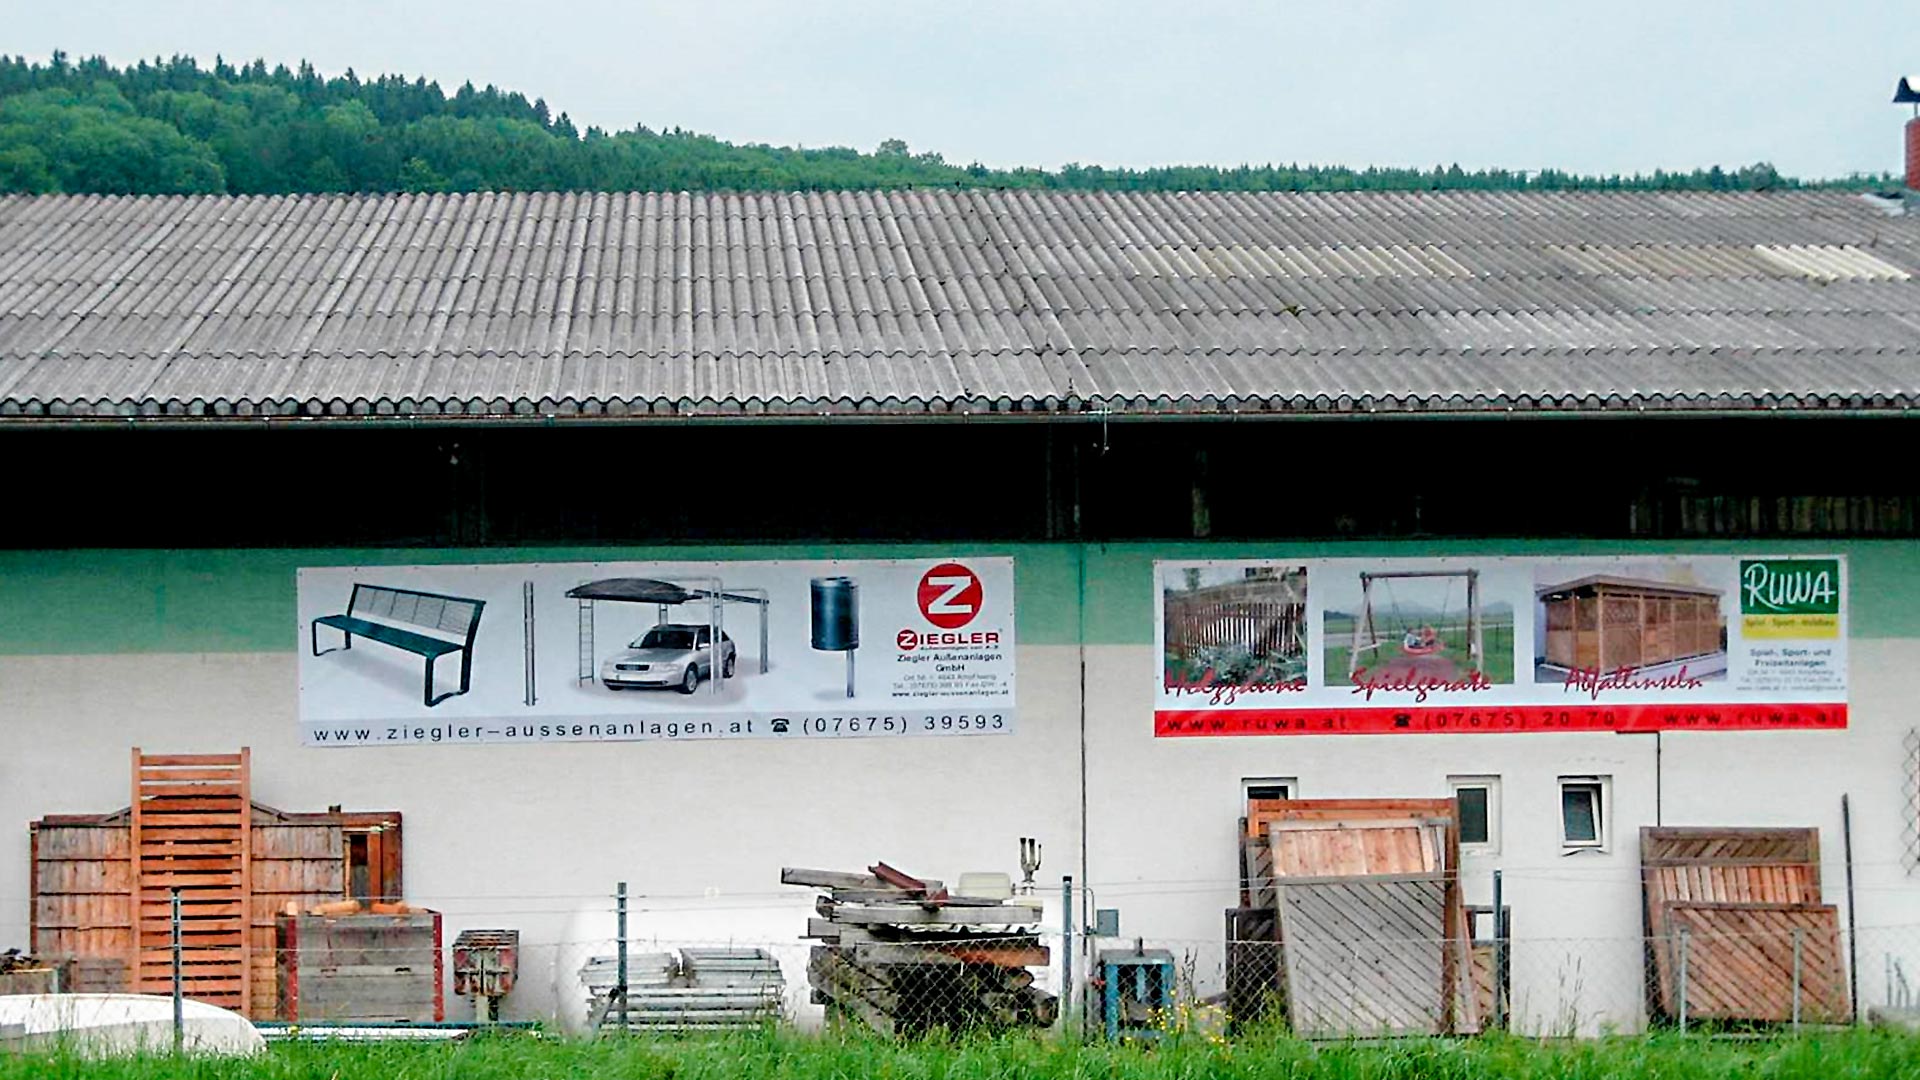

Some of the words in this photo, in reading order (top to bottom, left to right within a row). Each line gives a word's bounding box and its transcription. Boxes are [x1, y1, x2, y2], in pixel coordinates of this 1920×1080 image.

[927, 575, 973, 614] Z
[1743, 562, 1837, 611] RUWA
[897, 629, 999, 651] ZIEGLER
[897, 654, 931, 664] Ziegler
[935, 664, 965, 672] GmbH
[803, 716, 907, 735] (07675)
[924, 714, 1004, 730] 39593
[1424, 711, 1527, 729] (07675)
[1542, 711, 1570, 725] 20
